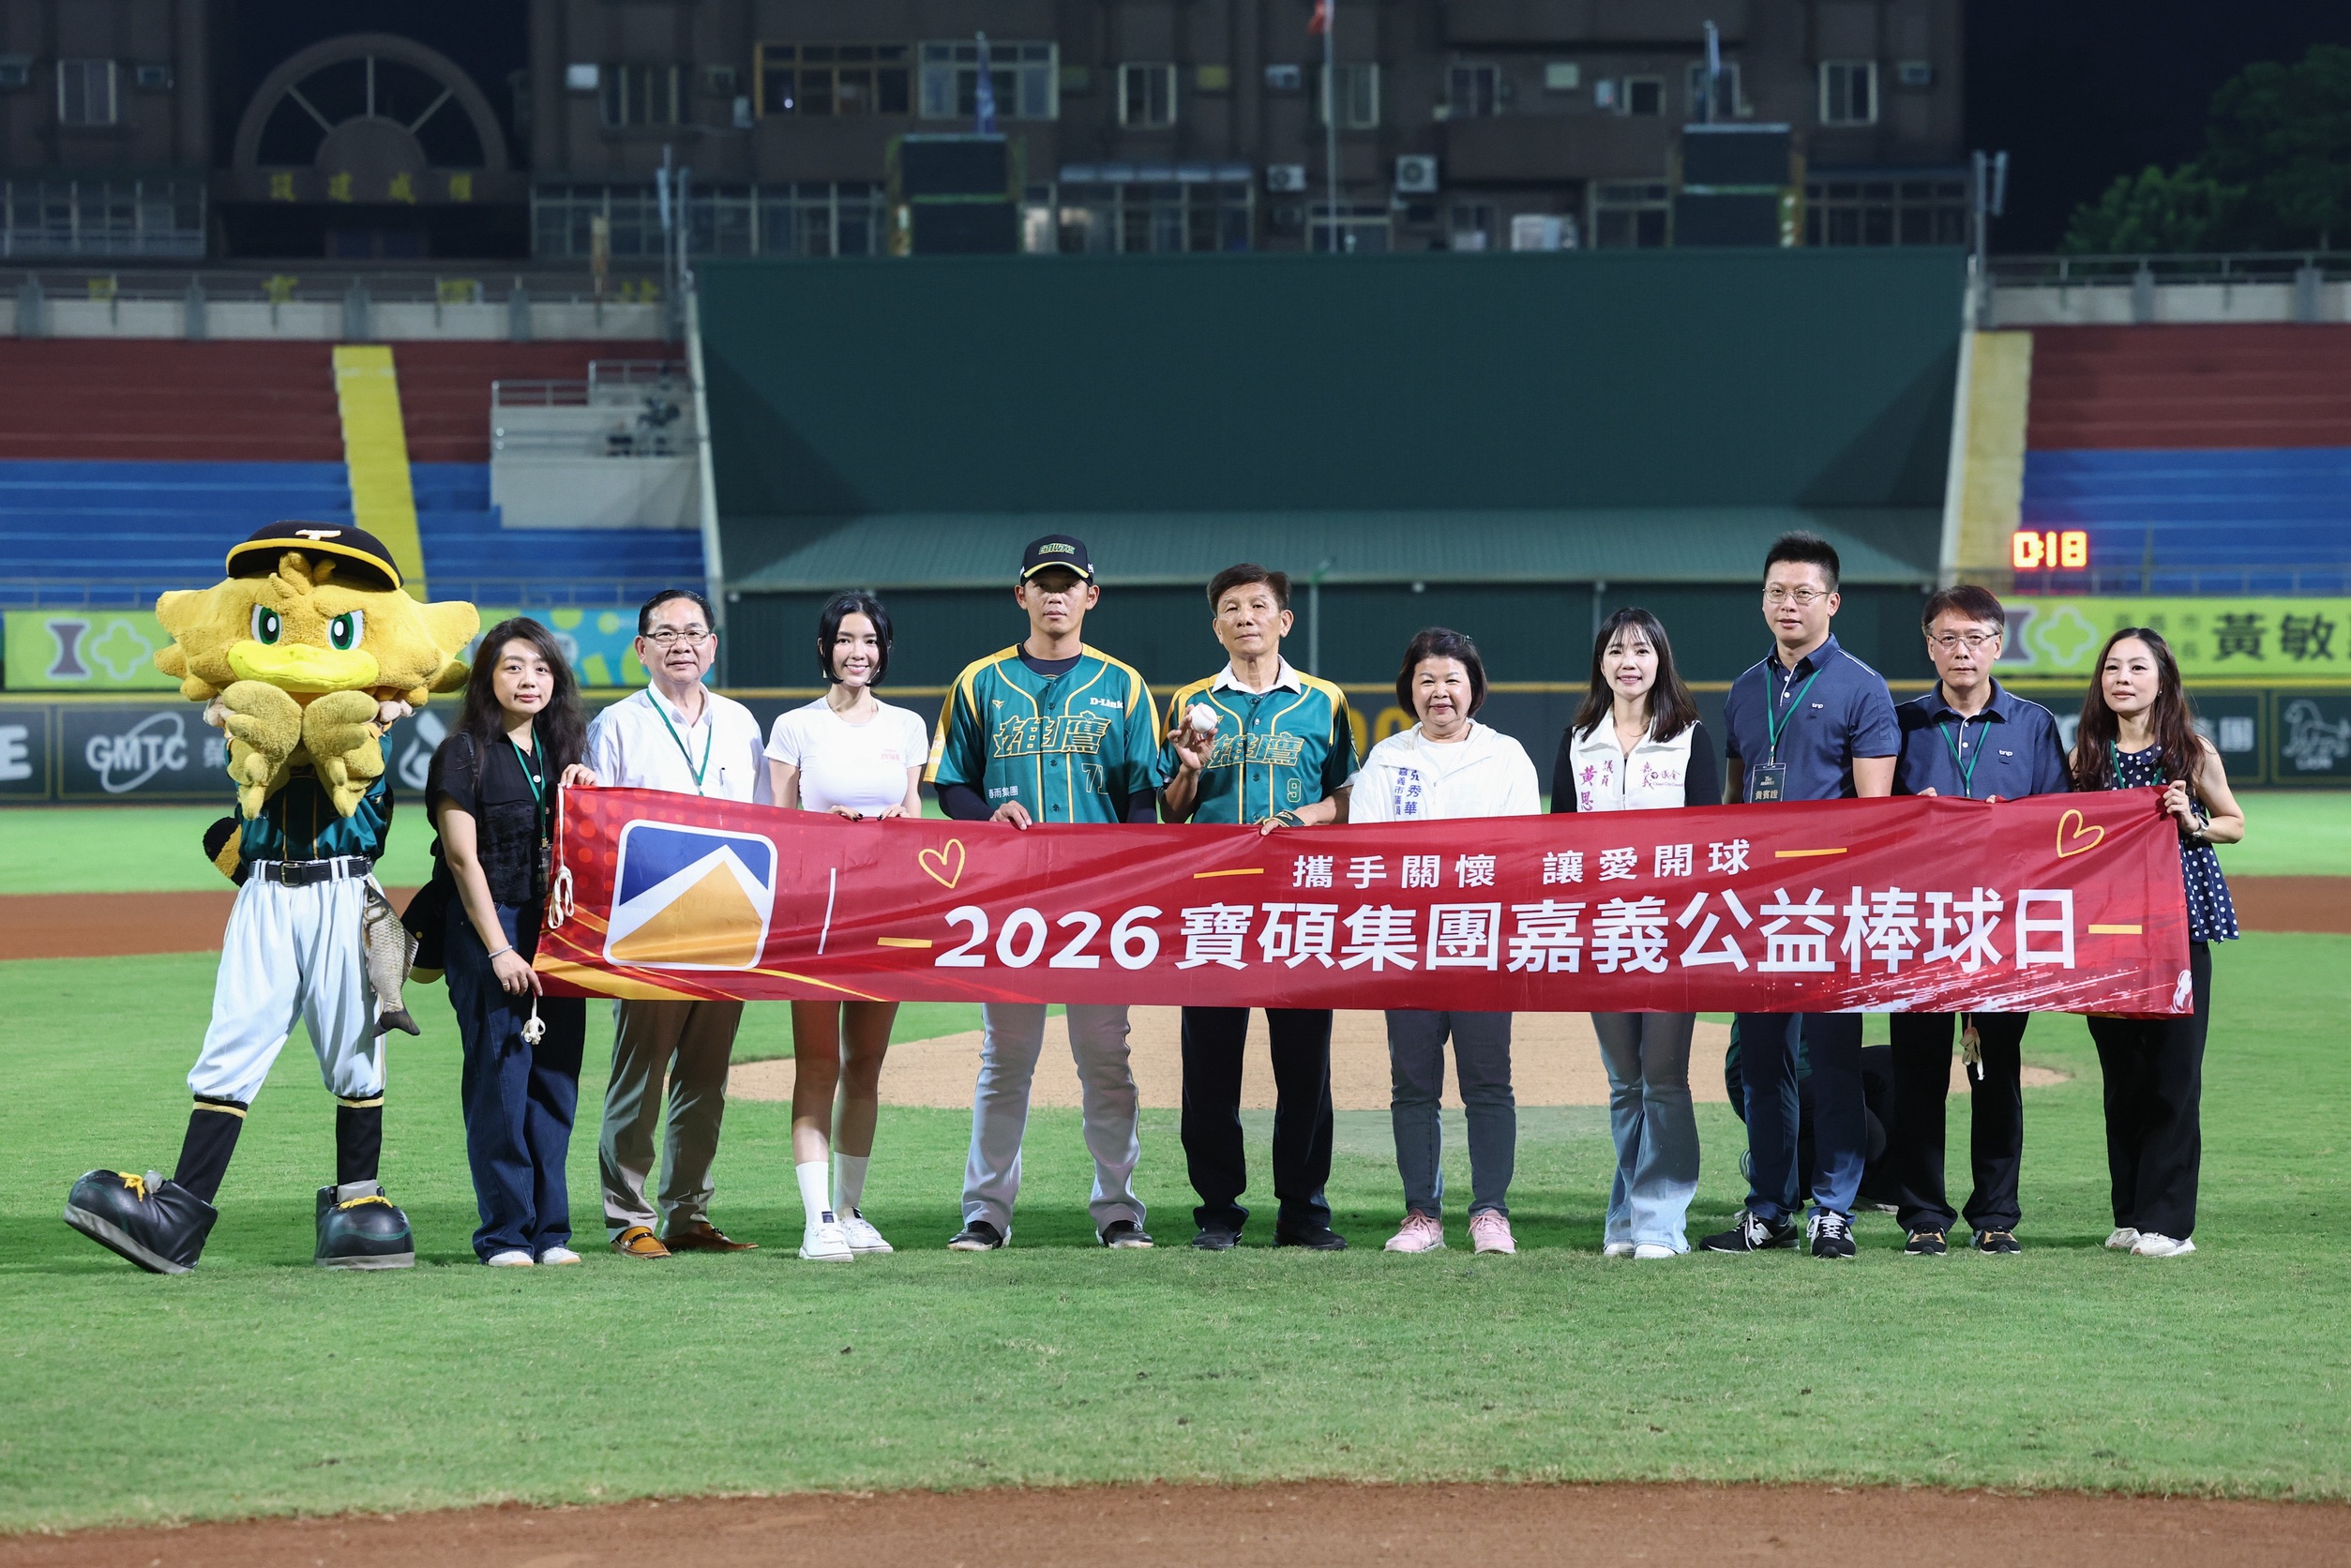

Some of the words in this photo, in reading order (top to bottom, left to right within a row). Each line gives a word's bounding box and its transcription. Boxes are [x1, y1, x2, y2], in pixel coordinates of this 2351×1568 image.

[2212, 611, 2351, 661] 黃敏
[1090, 697, 1123, 709] D-Link
[85, 734, 188, 772] GMTC
[993, 710, 1112, 758] 雄鷹
[1287, 777, 1302, 803] 9
[1292, 853, 1497, 889] 攜手關懷
[1542, 838, 1750, 884] 讓愛開球
